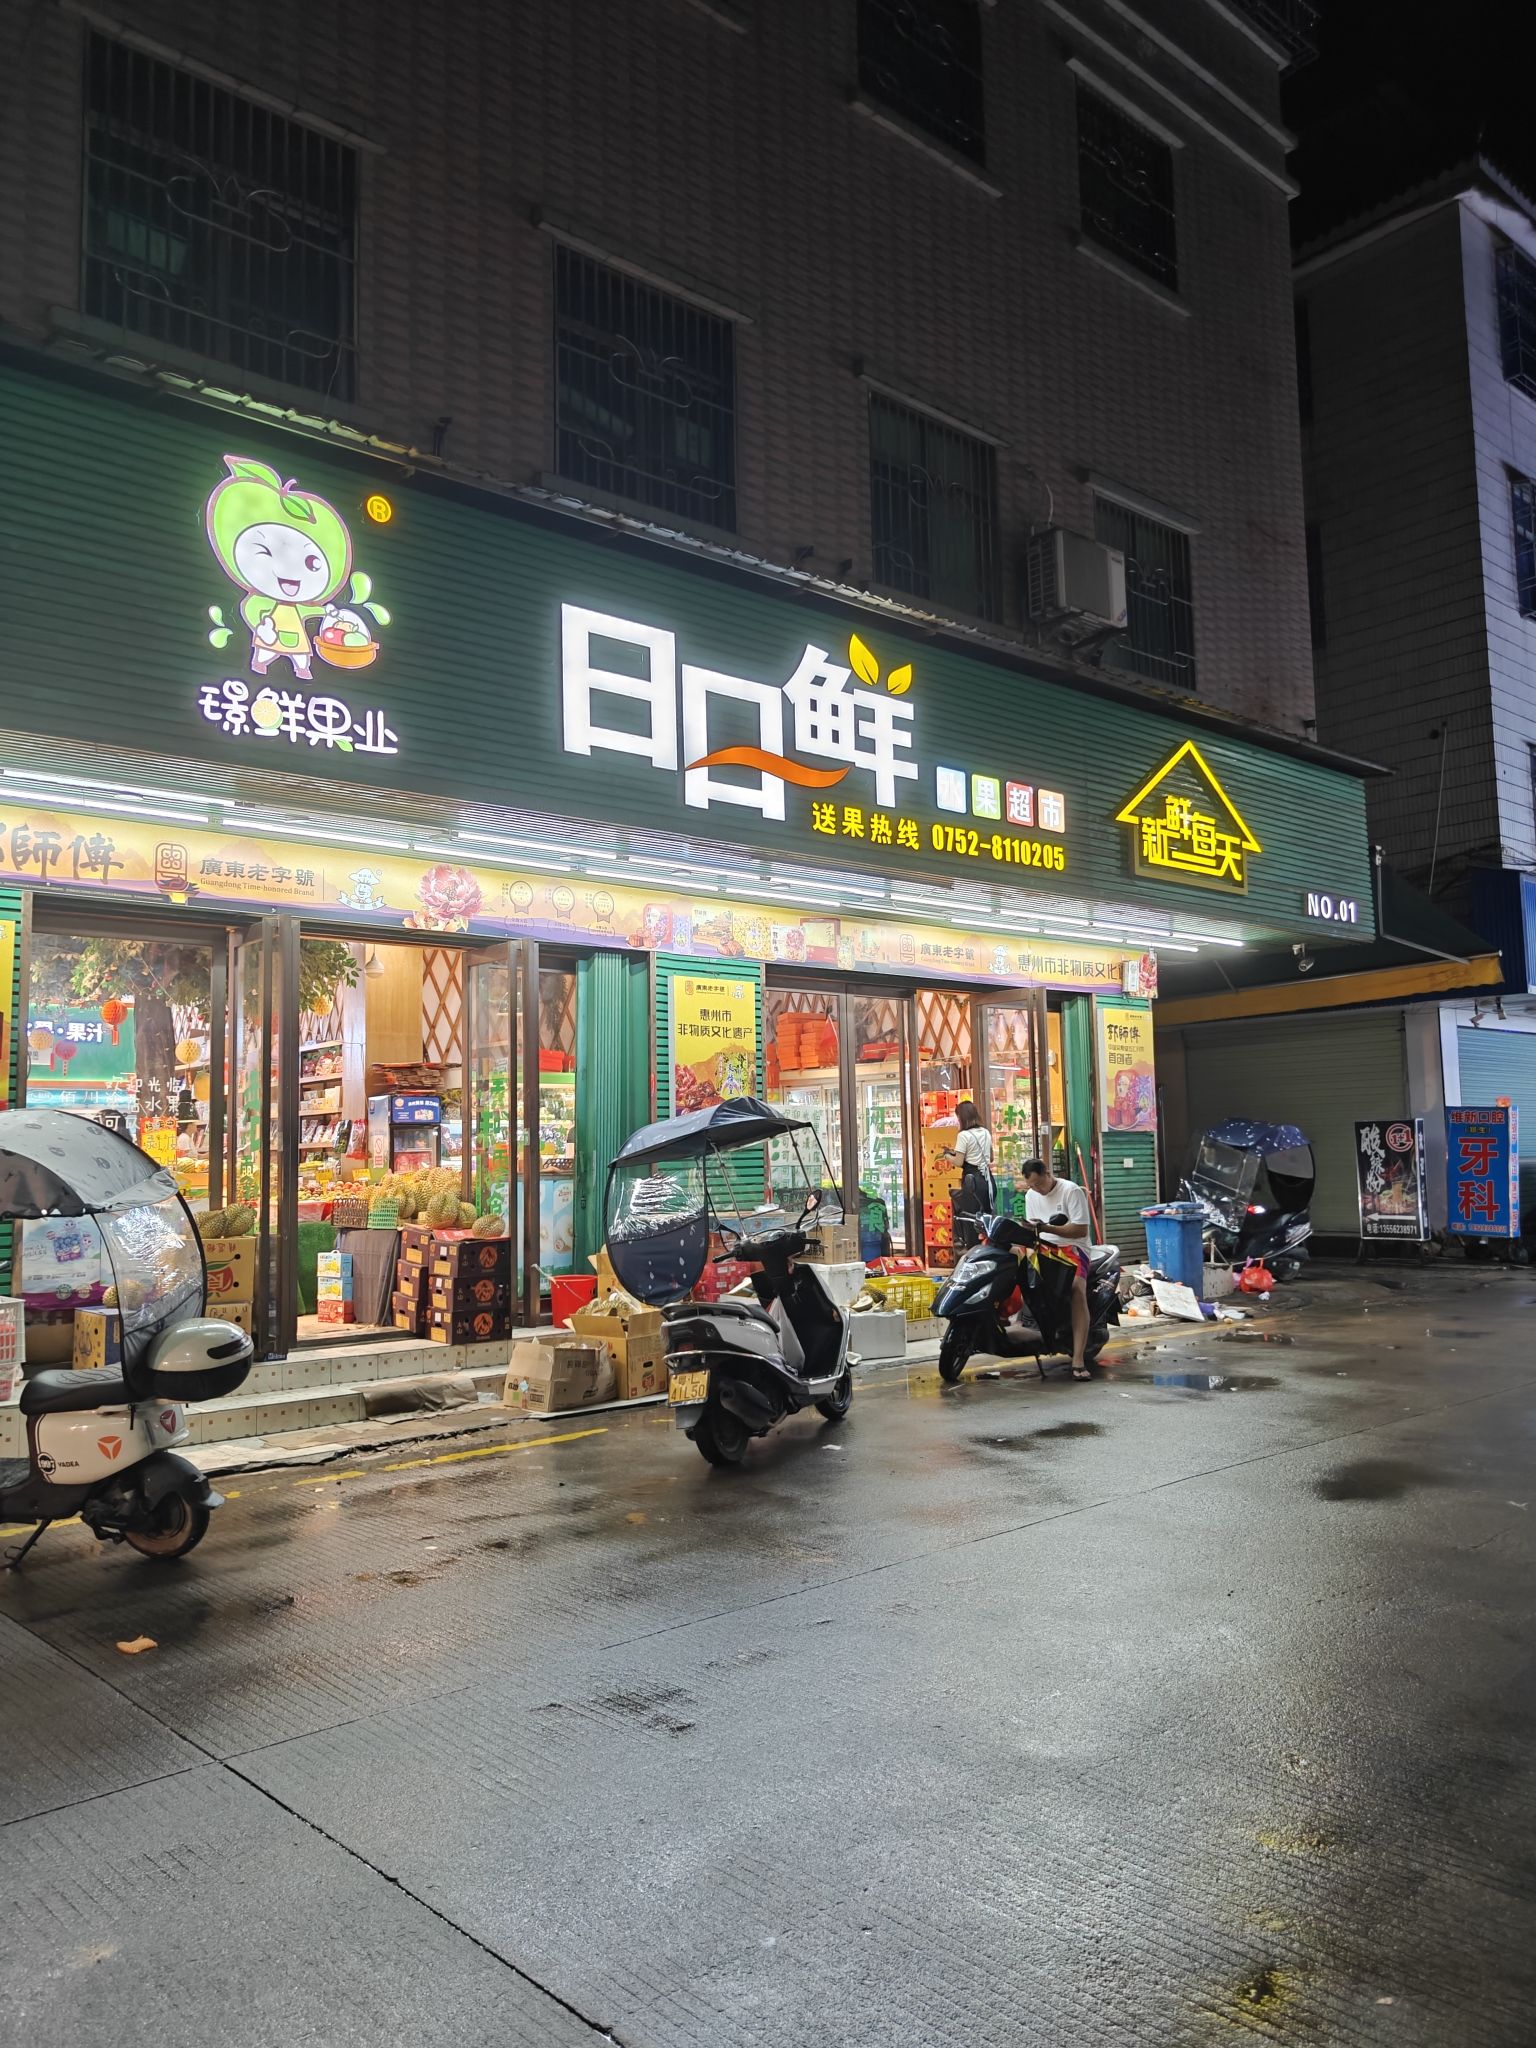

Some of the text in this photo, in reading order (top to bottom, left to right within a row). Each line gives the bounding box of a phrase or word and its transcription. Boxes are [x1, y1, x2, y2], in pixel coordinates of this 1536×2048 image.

[938, 770, 1064, 829] 水果超市
[811, 801, 1065, 872] 送果热线 0752-8110205
[199, 857, 316, 888] 廣東老字號
[200, 877, 242, 891] Guangdong
[293, 887, 315, 898] Brand
[1307, 892, 1358, 924] NO.01
[699, 1008, 732, 1023] 惠州市
[677, 1023, 753, 1040] 非物质文化遗产
[104, 1075, 182, 1094] 欢迎光临
[1450, 1111, 1505, 1125] 维新口腔
[1458, 1136, 1500, 1221] 牙科
